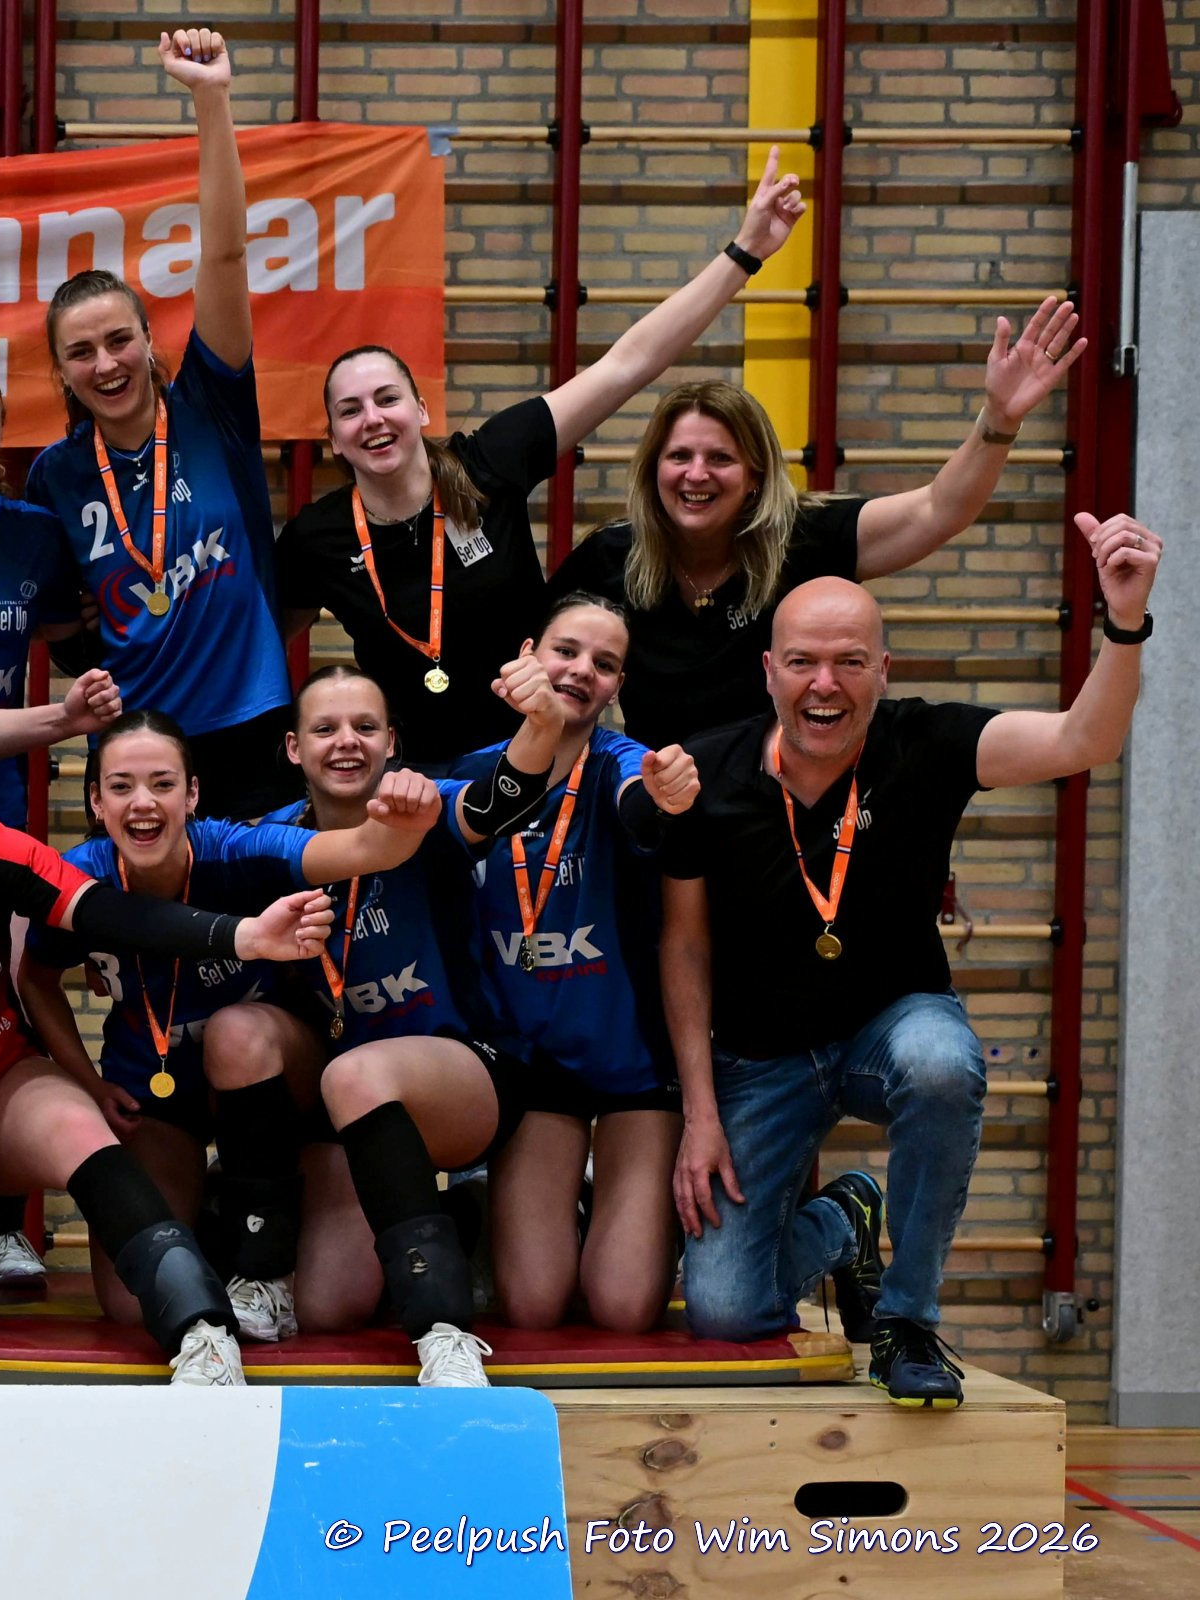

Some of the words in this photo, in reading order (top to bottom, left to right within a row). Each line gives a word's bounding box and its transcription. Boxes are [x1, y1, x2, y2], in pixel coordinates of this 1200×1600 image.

[81, 501, 115, 562] 2
[456, 542, 478, 564] Set
[473, 536, 491, 554] Up
[15, 606, 28, 635] Up
[366, 907, 390, 936] Up
[491, 924, 604, 967] VBK
[198, 964, 226, 988] Set
